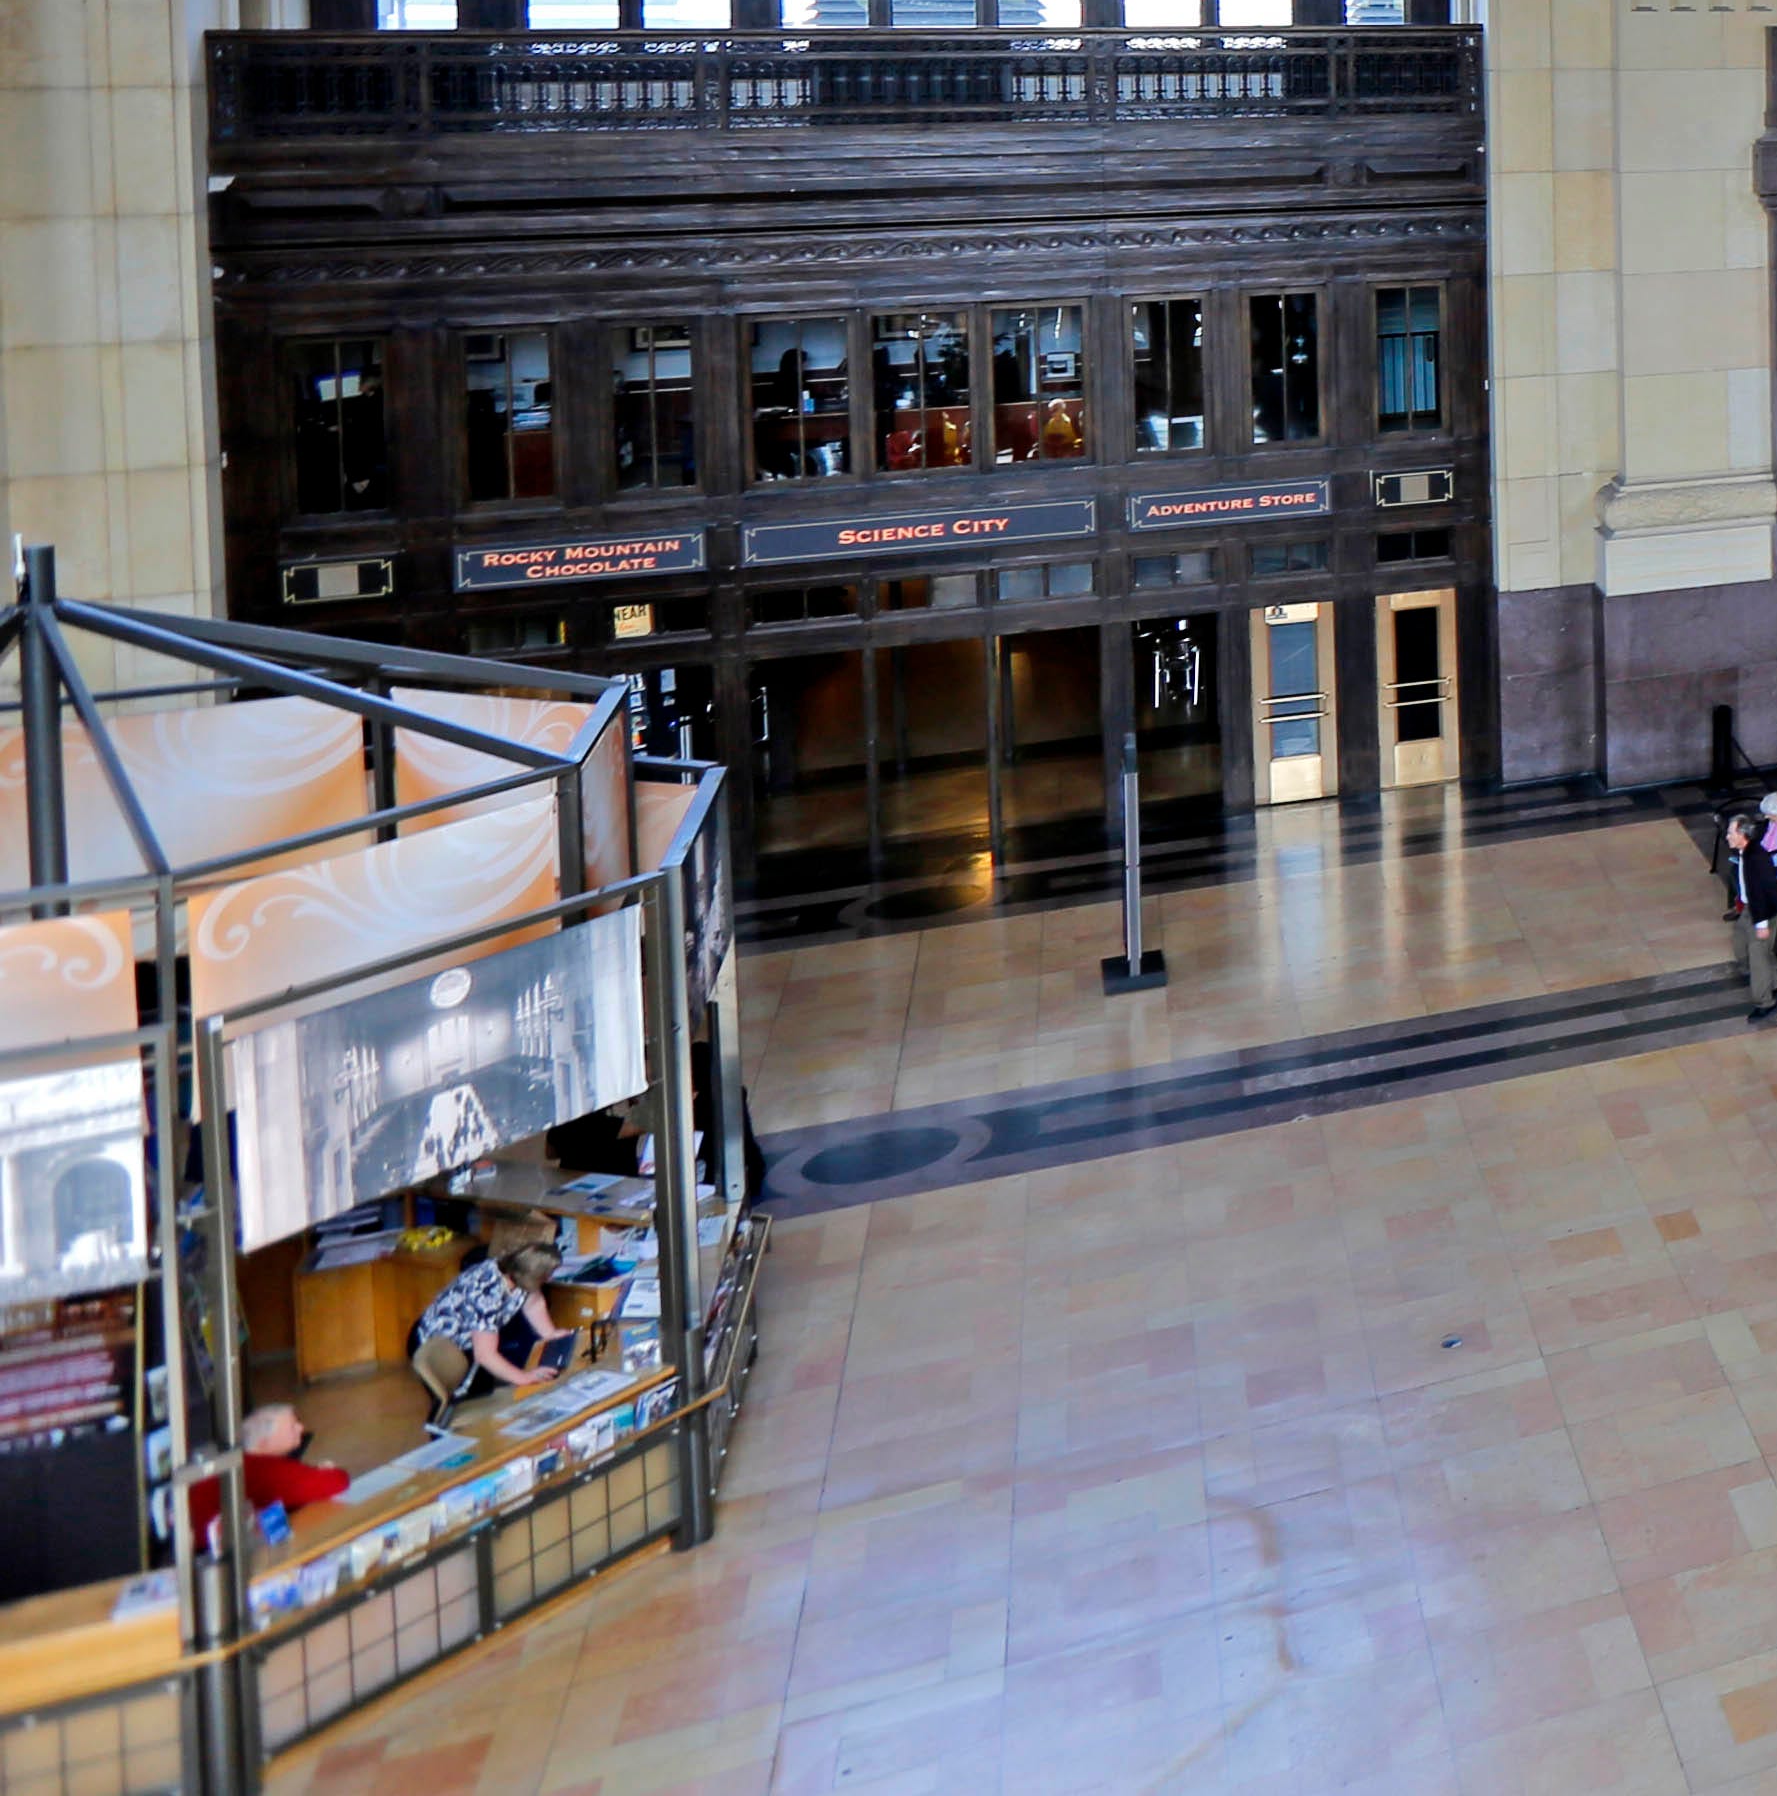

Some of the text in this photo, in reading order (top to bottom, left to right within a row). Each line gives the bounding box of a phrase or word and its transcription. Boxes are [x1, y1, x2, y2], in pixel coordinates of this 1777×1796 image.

[1146, 492, 1317, 518] ADVENTURE STORE
[838, 517, 1010, 545] SCIENCE CITY
[482, 539, 681, 568] ROCKY MOUNTAIN
[526, 556, 657, 579] CHOCOLATE
